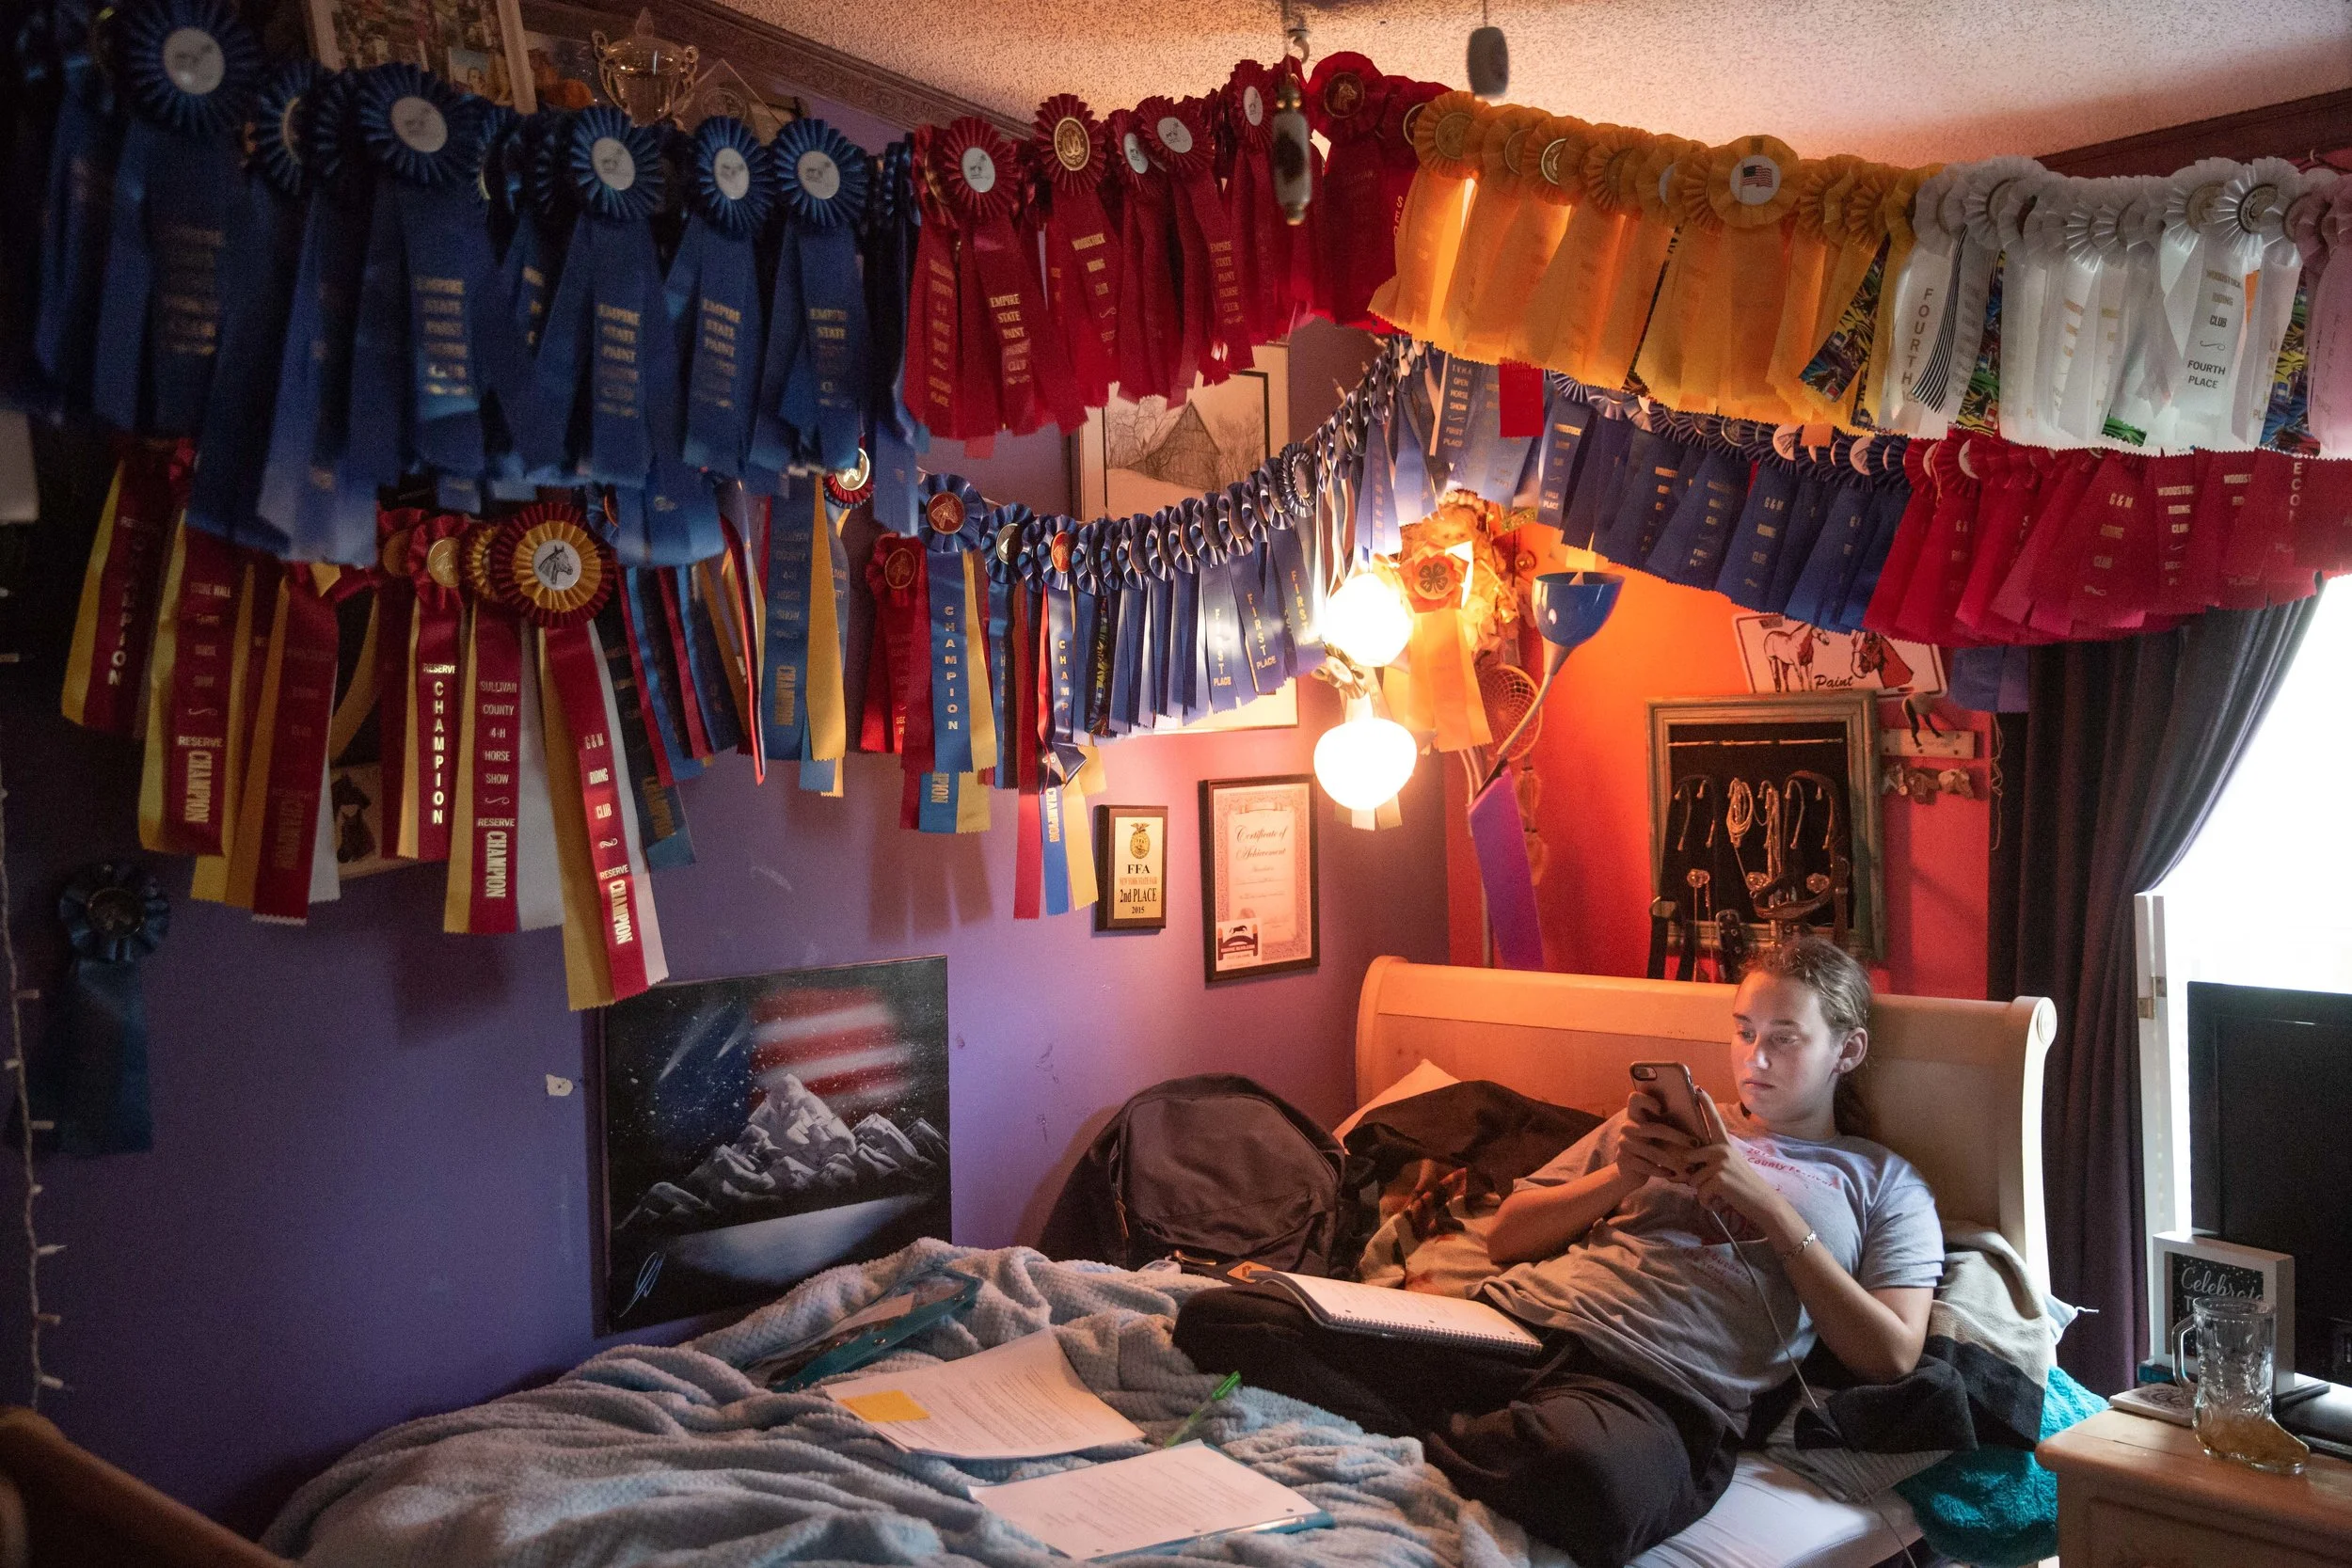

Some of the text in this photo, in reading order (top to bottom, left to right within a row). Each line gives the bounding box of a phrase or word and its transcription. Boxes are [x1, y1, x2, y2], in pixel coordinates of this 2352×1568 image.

[990, 293, 1022, 309] EMPIRE
[996, 309, 1022, 325] STATE
[2209, 314, 2228, 328] CLUB
[1901, 288, 1934, 386] FOURTH
[2186, 359, 2227, 375] FOURTH
[2187, 374, 2219, 389] PLACE
[1449, 402, 1468, 412] SHOW
[2223, 473, 2253, 484] WOODST
[2156, 484, 2195, 497] WOODSTOC
[1247, 593, 1266, 657] FIRST
[1214, 608, 1225, 674] FST
[944, 606, 959, 730] CHAMPION
[1255, 655, 1278, 671] PLACE
[480, 680, 517, 693] SULLIVAN
[1213, 675, 1232, 687] PLACE
[1814, 673, 1854, 690] Paint
[483, 705, 515, 717] COUNTY
[490, 727, 506, 738] 4-H
[177, 736, 224, 748] RESERVE
[433, 680, 445, 825] CHAMPION
[485, 750, 511, 762] HORSE
[485, 772, 509, 785] SHOW
[183, 751, 213, 824] CHAMPION
[596, 802, 612, 819] CLUB
[1044, 786, 1060, 844] CHAMPION
[477, 817, 516, 828] RESERVE
[1235, 824, 1289, 844] Certificate of
[1235, 847, 1287, 862] Achievement
[485, 830, 507, 898] CHAMPION
[598, 863, 629, 880] RESERVE
[1127, 863, 1151, 875] FFA
[1120, 887, 1157, 903] 2nd PLACE
[610, 879, 633, 945] CHAMPION
[1131, 906, 1145, 914] 2015
[1747, 1156, 1786, 1171] County
